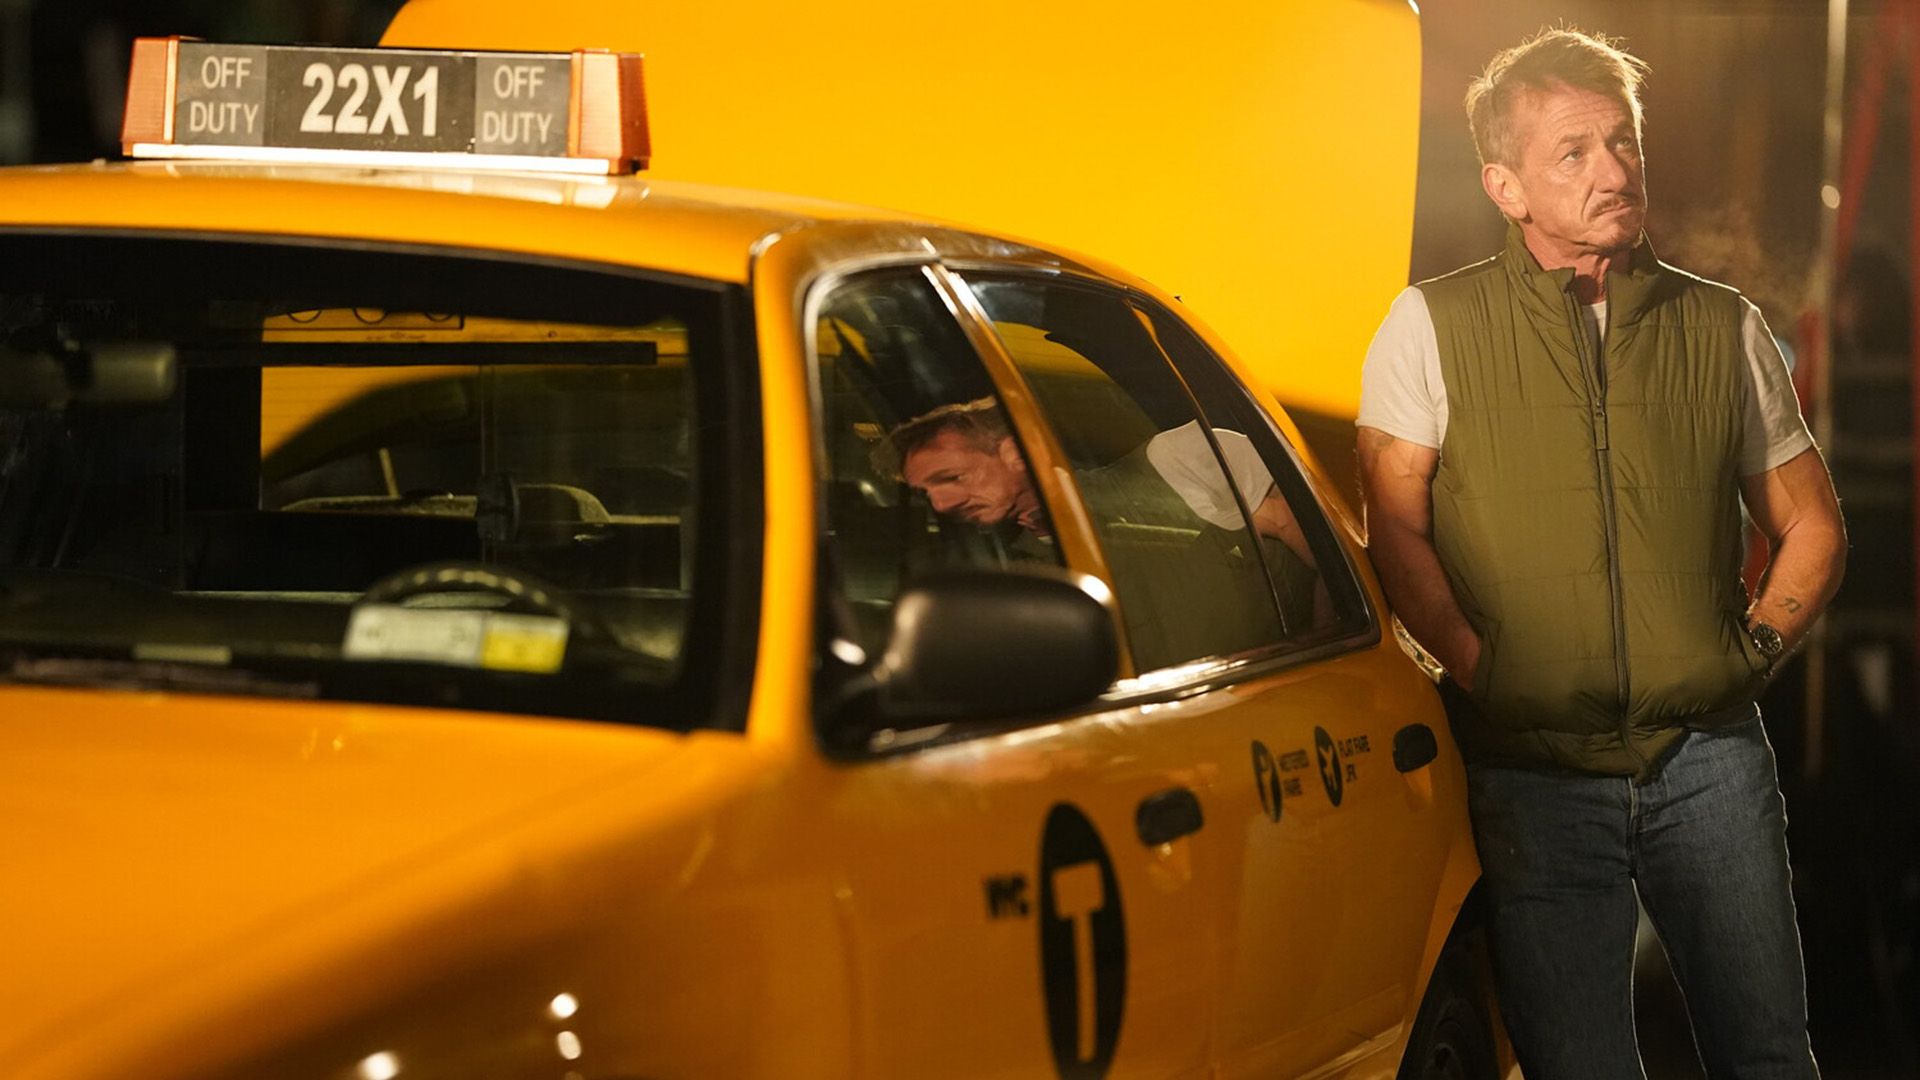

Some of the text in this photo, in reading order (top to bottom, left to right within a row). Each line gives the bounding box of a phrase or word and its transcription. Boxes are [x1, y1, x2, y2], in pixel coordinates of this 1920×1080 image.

[201, 55, 251, 90] OFF
[493, 64, 544, 99] OFF
[300, 63, 439, 137] 22X1
[189, 101, 260, 135] DUTY
[482, 110, 553, 144] DUTY
